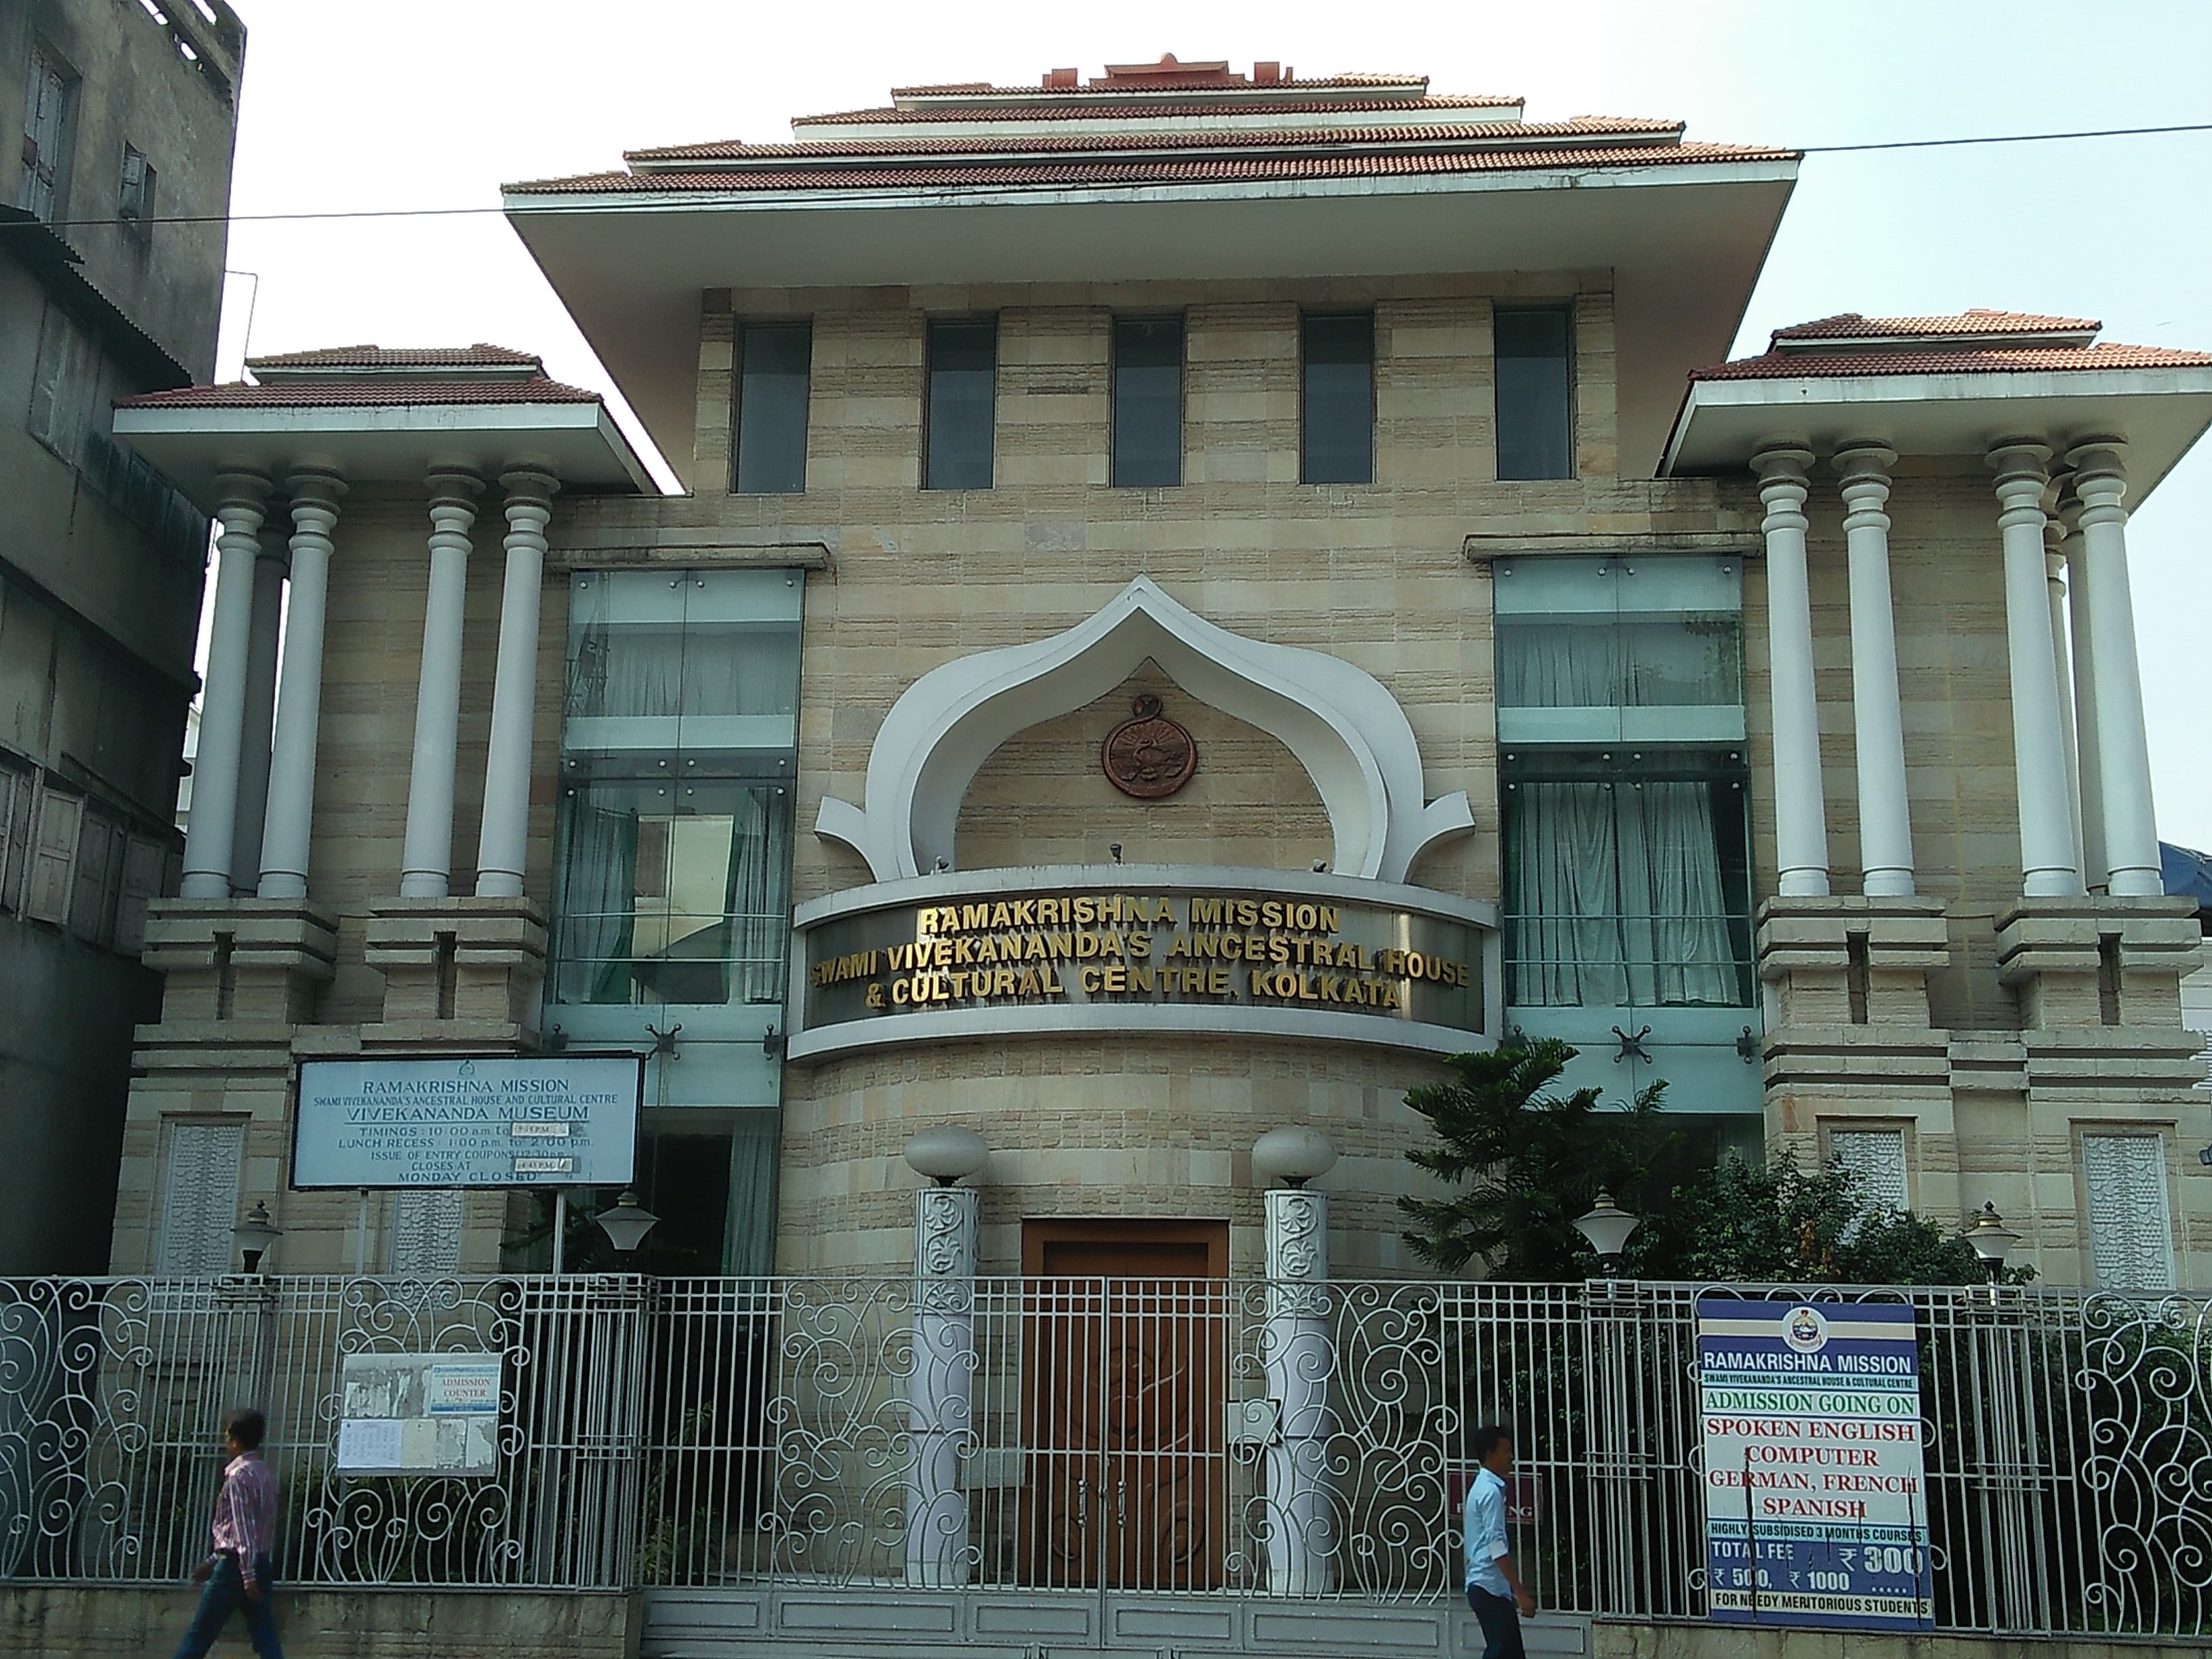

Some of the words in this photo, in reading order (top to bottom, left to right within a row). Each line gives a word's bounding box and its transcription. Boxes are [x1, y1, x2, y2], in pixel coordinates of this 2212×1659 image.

[920, 894, 1176, 935] RAMAKRISHNA
[1191, 897, 1340, 933] MISSION
[812, 949, 877, 986] SWAMI
[888, 930, 1151, 970] VIVEKANANDA'S
[1169, 933, 1375, 971] ANCESTRAL
[1386, 949, 1469, 987] HOUSE
[866, 982, 884, 1008] &
[892, 968, 1065, 1004] CULTURAL
[1252, 970, 1401, 1008] KOLKATA
[363, 1080, 493, 1094] RAMAKRISHNA
[501, 1079, 569, 1092] MISSION
[314, 1097, 341, 1106] SWAMI
[342, 1096, 411, 1106] VIVEKANANDA'S
[413, 1096, 468, 1105] ANCESTRAL
[471, 1095, 501, 1105] HOUSE
[505, 1095, 525, 1105] AND
[528, 1094, 576, 1105] CULTURAL
[579, 1094, 618, 1104] CENTRE
[347, 1107, 489, 1120] VIVEKANANDA
[499, 1106, 588, 1120] MUSEUM
[359, 1127, 417, 1136] TIMINGS
[496, 1125, 508, 1136] to
[339, 1139, 382, 1148] LUNCH
[387, 1139, 434, 1147] RECESS
[509, 1138, 522, 1147] to
[371, 1151, 402, 1160] ISSUE
[407, 1151, 421, 1160] OF
[425, 1151, 461, 1160] ENTRY
[398, 1173, 461, 1182] MONDAY
[469, 1172, 537, 1182] CLOSED
[411, 1162, 453, 1171] CLOSES
[457, 1162, 472, 1170] AT
[1704, 1351, 1832, 1372] RAMAKRISHNA
[1837, 1354, 1912, 1374] MISSION
[441, 1378, 491, 1387] ADMISSION
[1704, 1373, 1728, 1382] SWAMI
[1729, 1374, 1782, 1385] VIVEKANANDA'S
[1783, 1375, 1821, 1385] ANCESTRAL
[1822, 1376, 1845, 1387] HOUSE
[1845, 1377, 1851, 1387] &
[1852, 1377, 1887, 1388] CULTURAL
[1887, 1378, 1913, 1388] CENTRE
[1705, 1391, 1813, 1411] ADMISSION
[1819, 1394, 1882, 1414] GOING
[1887, 1396, 1914, 1415] ON
[1707, 1418, 1801, 1437] SPOKEN
[1809, 1421, 1916, 1441] ENGLISH
[1746, 1445, 1880, 1467] COMPUTER
[1709, 1469, 1816, 1493] GERMAN,
[1823, 1473, 1918, 1494] FRENCH
[1763, 1497, 1866, 1518] SPANISH
[1712, 1523, 1747, 1535] HIGHLY
[1753, 1525, 1814, 1538] SUBSIDISED
[1816, 1527, 1823, 1538] 3
[1825, 1527, 1870, 1540] MONTHS
[1872, 1529, 1922, 1542] COURSES
[1711, 1542, 1763, 1559] TOTAL
[1767, 1543, 1794, 1559] FEE
[1864, 1546, 1923, 1575] 300
[1807, 1570, 1850, 1591] 1000
[1715, 1593, 1738, 1606] FOR
[1740, 1594, 1779, 1608] NEEDY
[1782, 1595, 1862, 1612] MERITORIOUS
[1864, 1599, 1928, 1614] STUDENTS
